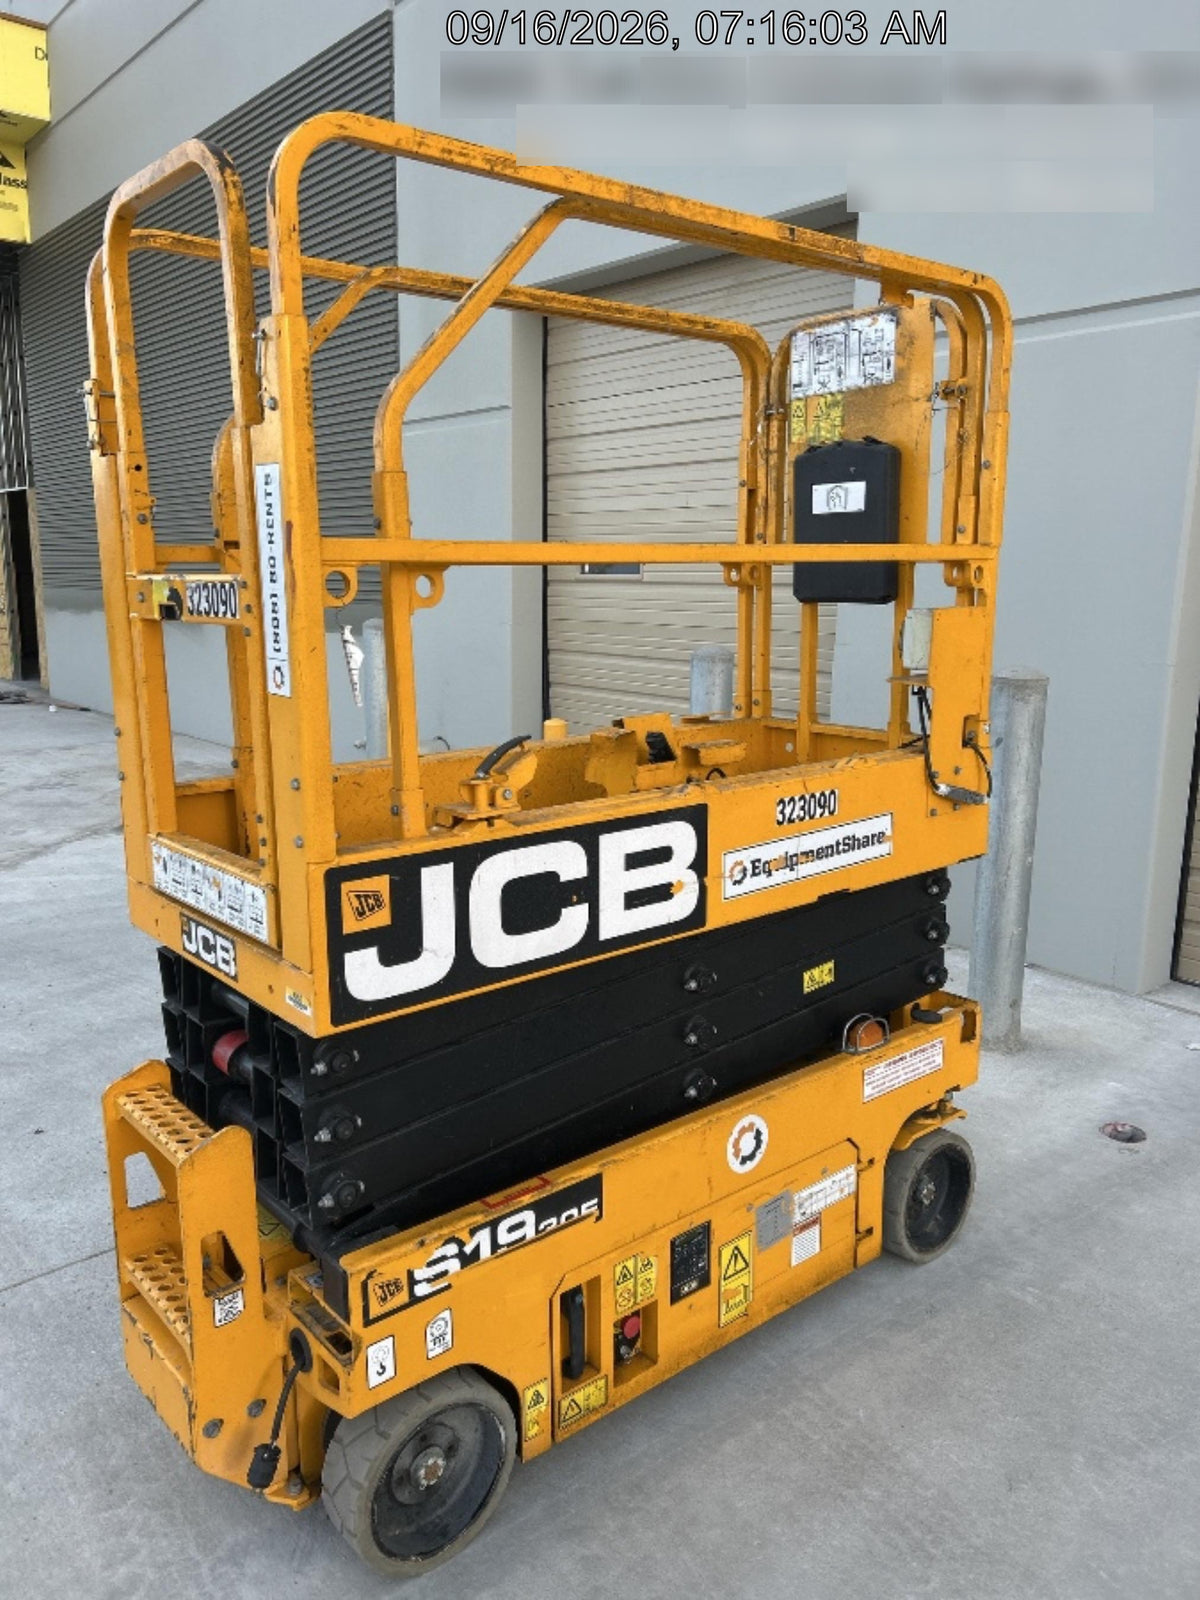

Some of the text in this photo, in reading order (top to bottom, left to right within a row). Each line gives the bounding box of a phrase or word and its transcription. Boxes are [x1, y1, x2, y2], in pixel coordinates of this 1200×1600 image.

[187, 582, 238, 618] 323090
[777, 789, 837, 826] 323090
[344, 820, 700, 1001] JCB
[354, 893, 384, 918] JCB
[182, 919, 236, 977] JCB
